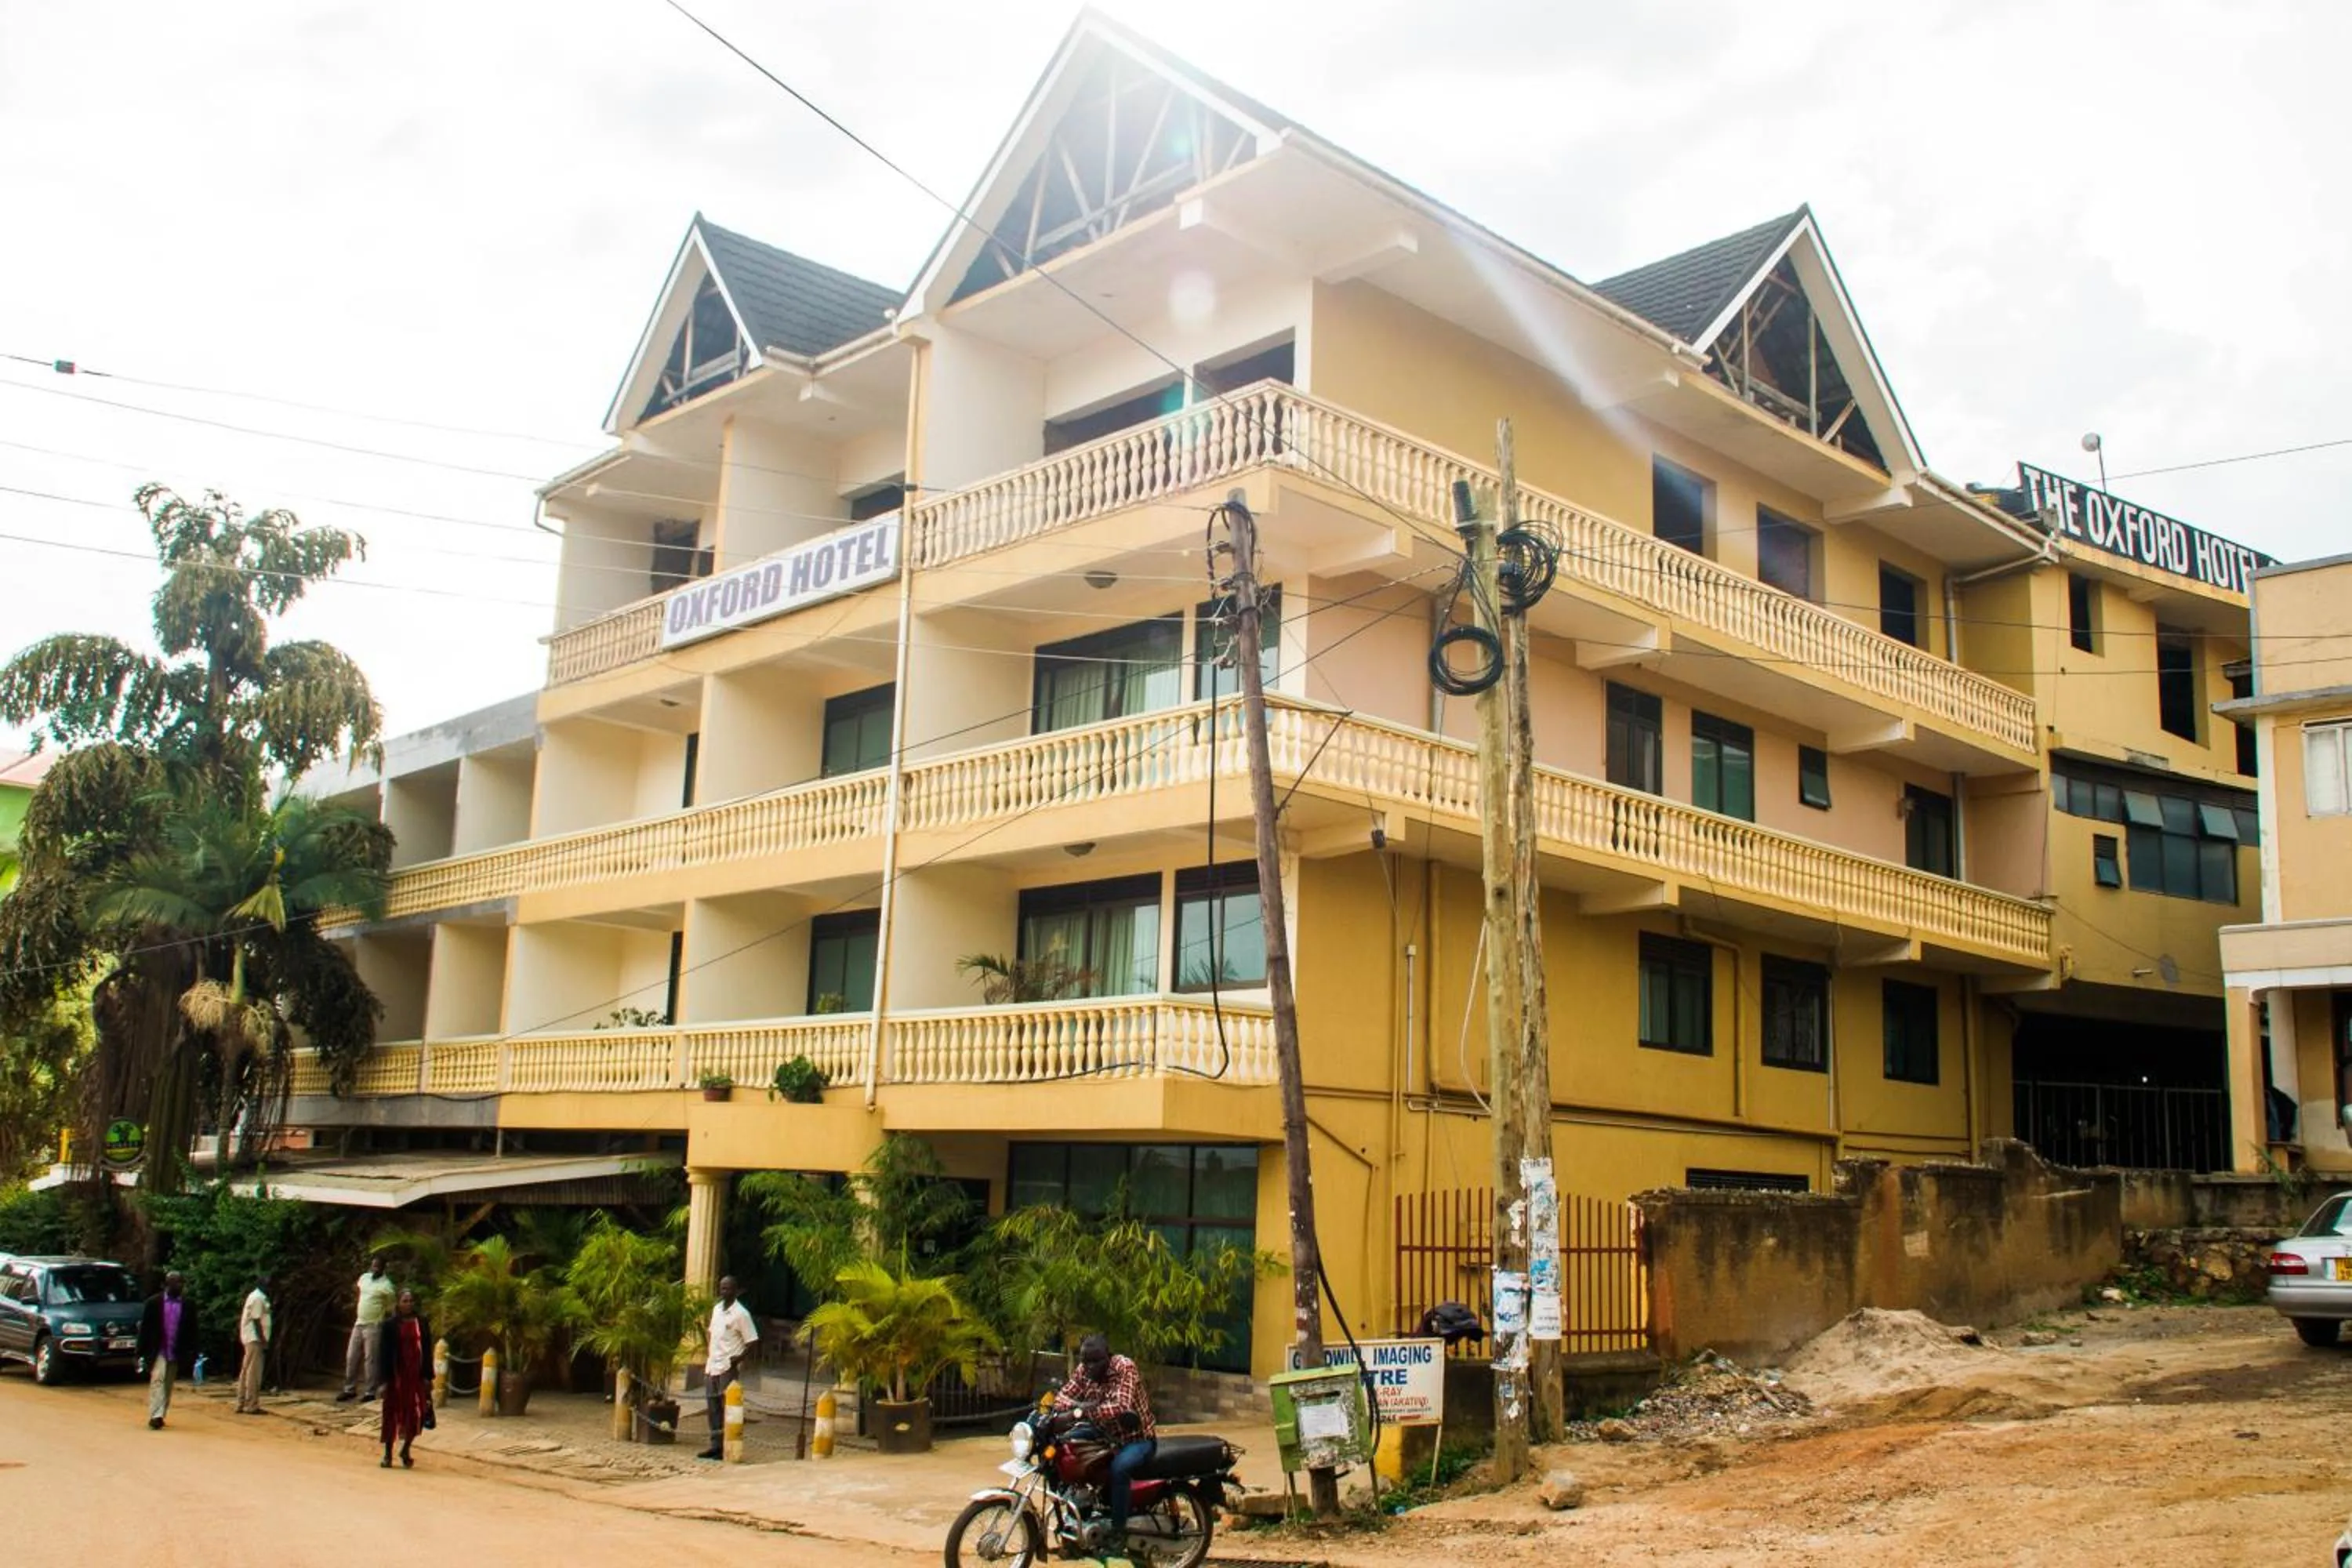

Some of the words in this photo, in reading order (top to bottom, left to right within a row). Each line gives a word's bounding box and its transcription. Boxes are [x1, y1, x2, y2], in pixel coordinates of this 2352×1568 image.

[2024, 466, 2082, 537] THE
[2085, 490, 2189, 575] OXFORD
[670, 562, 783, 635] OXFORD
[789, 526, 891, 596] HOTEL
[1373, 1345, 1432, 1365] IMAGING
